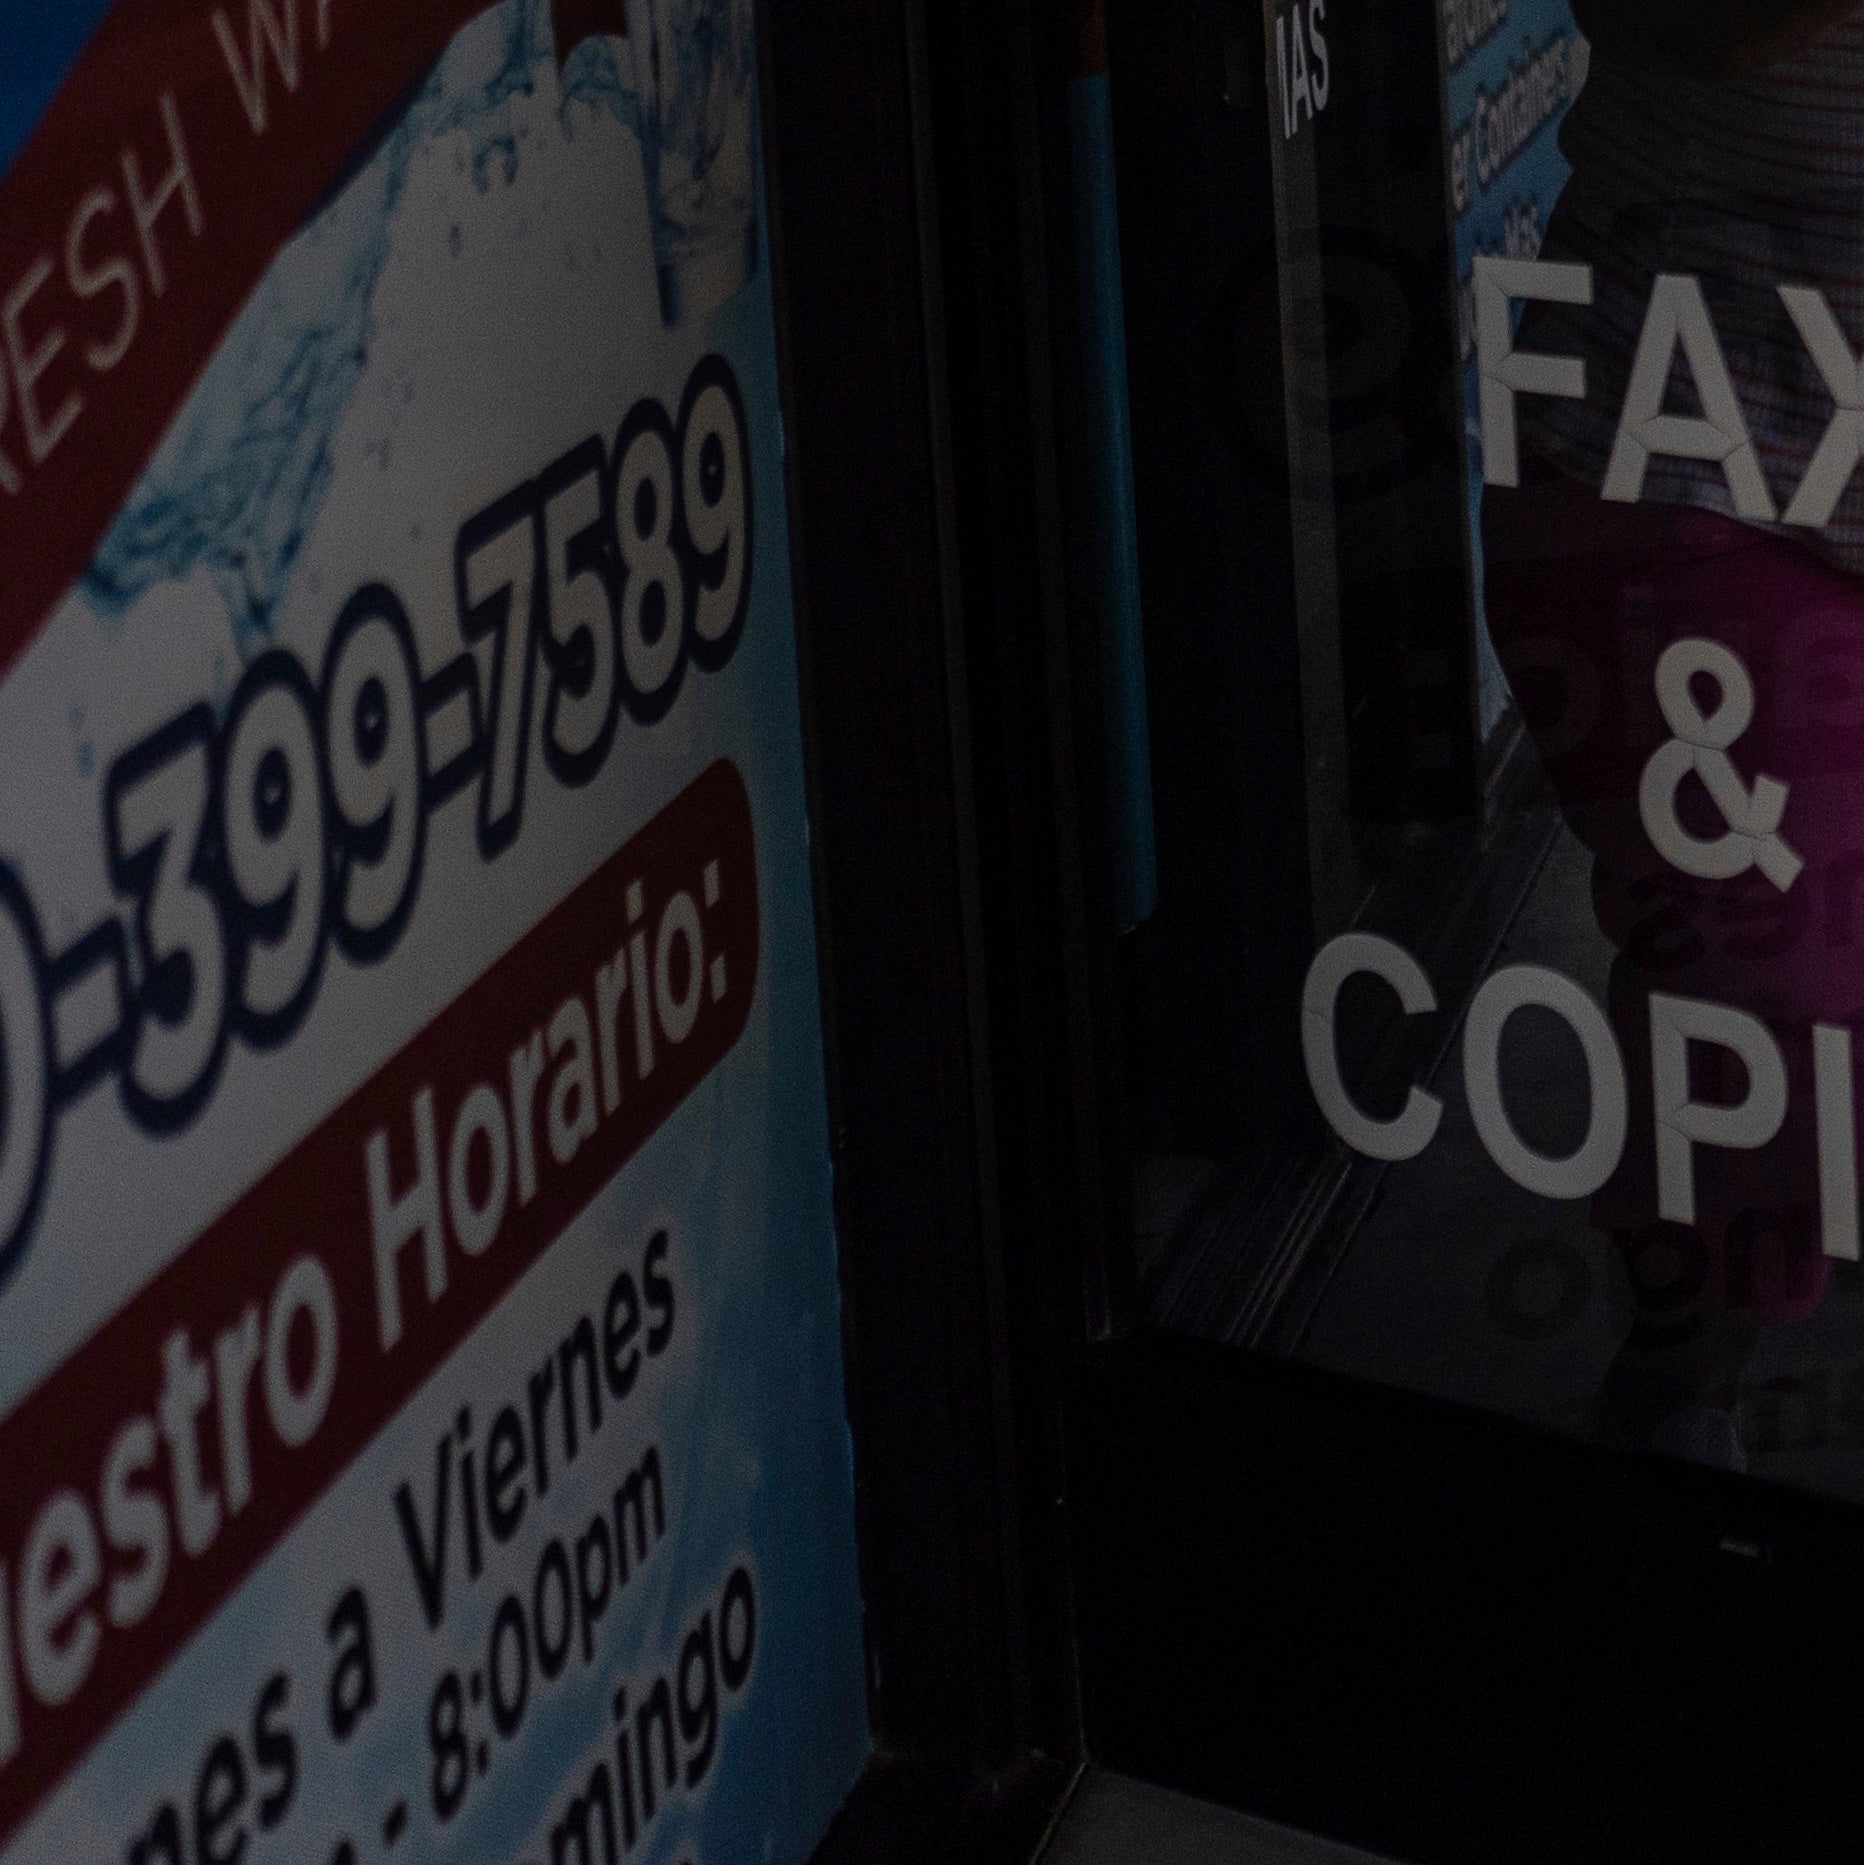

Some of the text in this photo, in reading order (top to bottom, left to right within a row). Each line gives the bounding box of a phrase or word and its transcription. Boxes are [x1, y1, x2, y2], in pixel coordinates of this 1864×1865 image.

[0, 85, 202, 497] ESH
[1636, 636, 1804, 893] &
[364, 856, 729, 1353] Horario:
[328, 1586, 377, 1742] a
[394, 1228, 675, 1630] Viernes
[429, 1446, 666, 1820] 8:00pm
